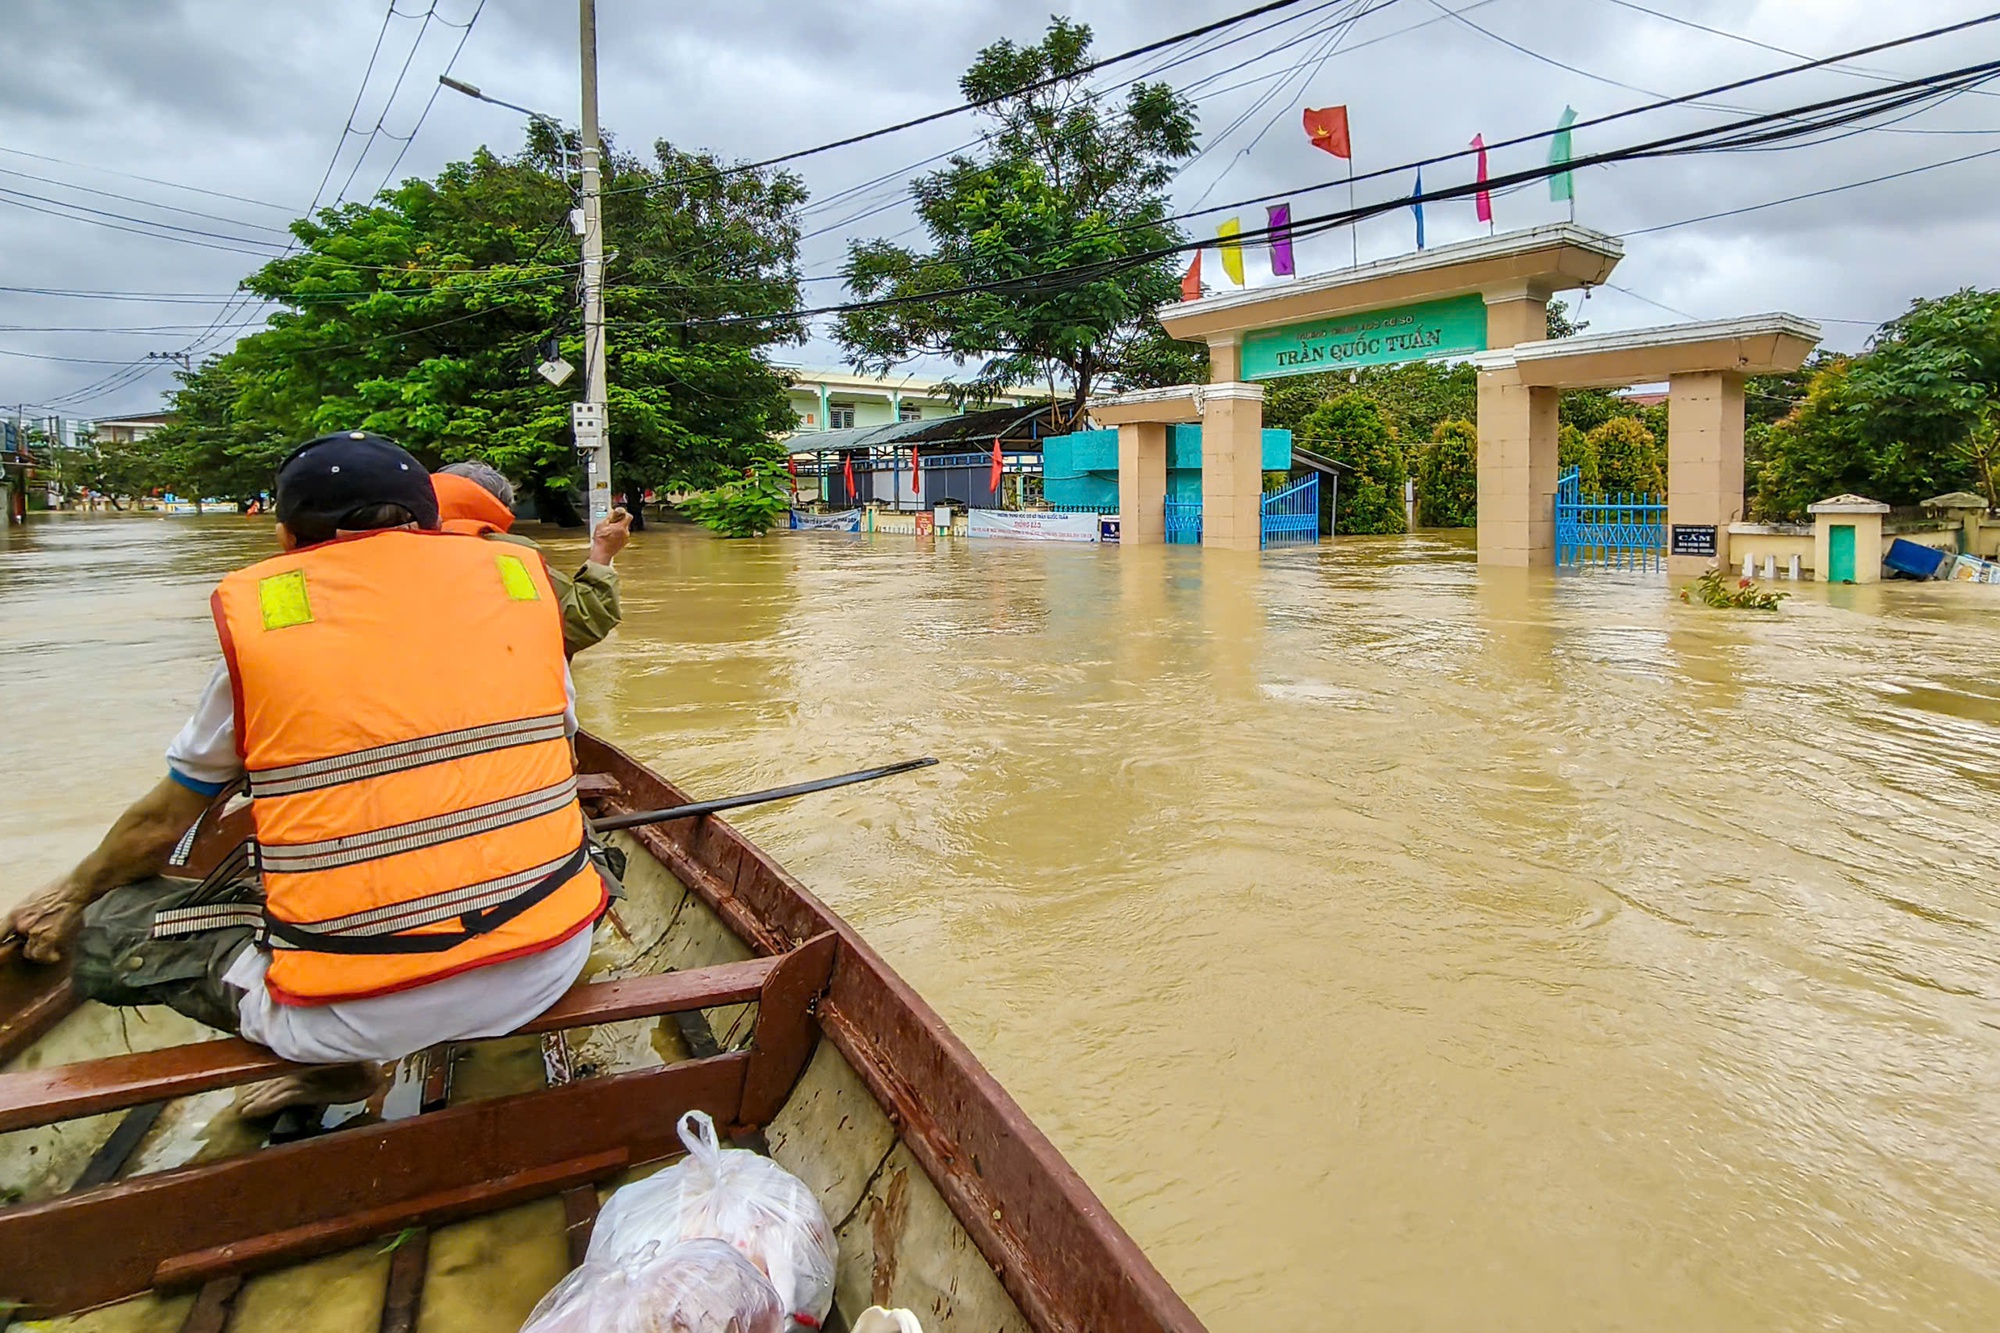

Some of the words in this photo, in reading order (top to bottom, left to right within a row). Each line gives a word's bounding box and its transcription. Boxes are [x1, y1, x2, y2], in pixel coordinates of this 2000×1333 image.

[1276, 341, 1325, 366] TRẦN
[1330, 332, 1380, 362] QUỐC
[1385, 324, 1442, 352] TUẤN
